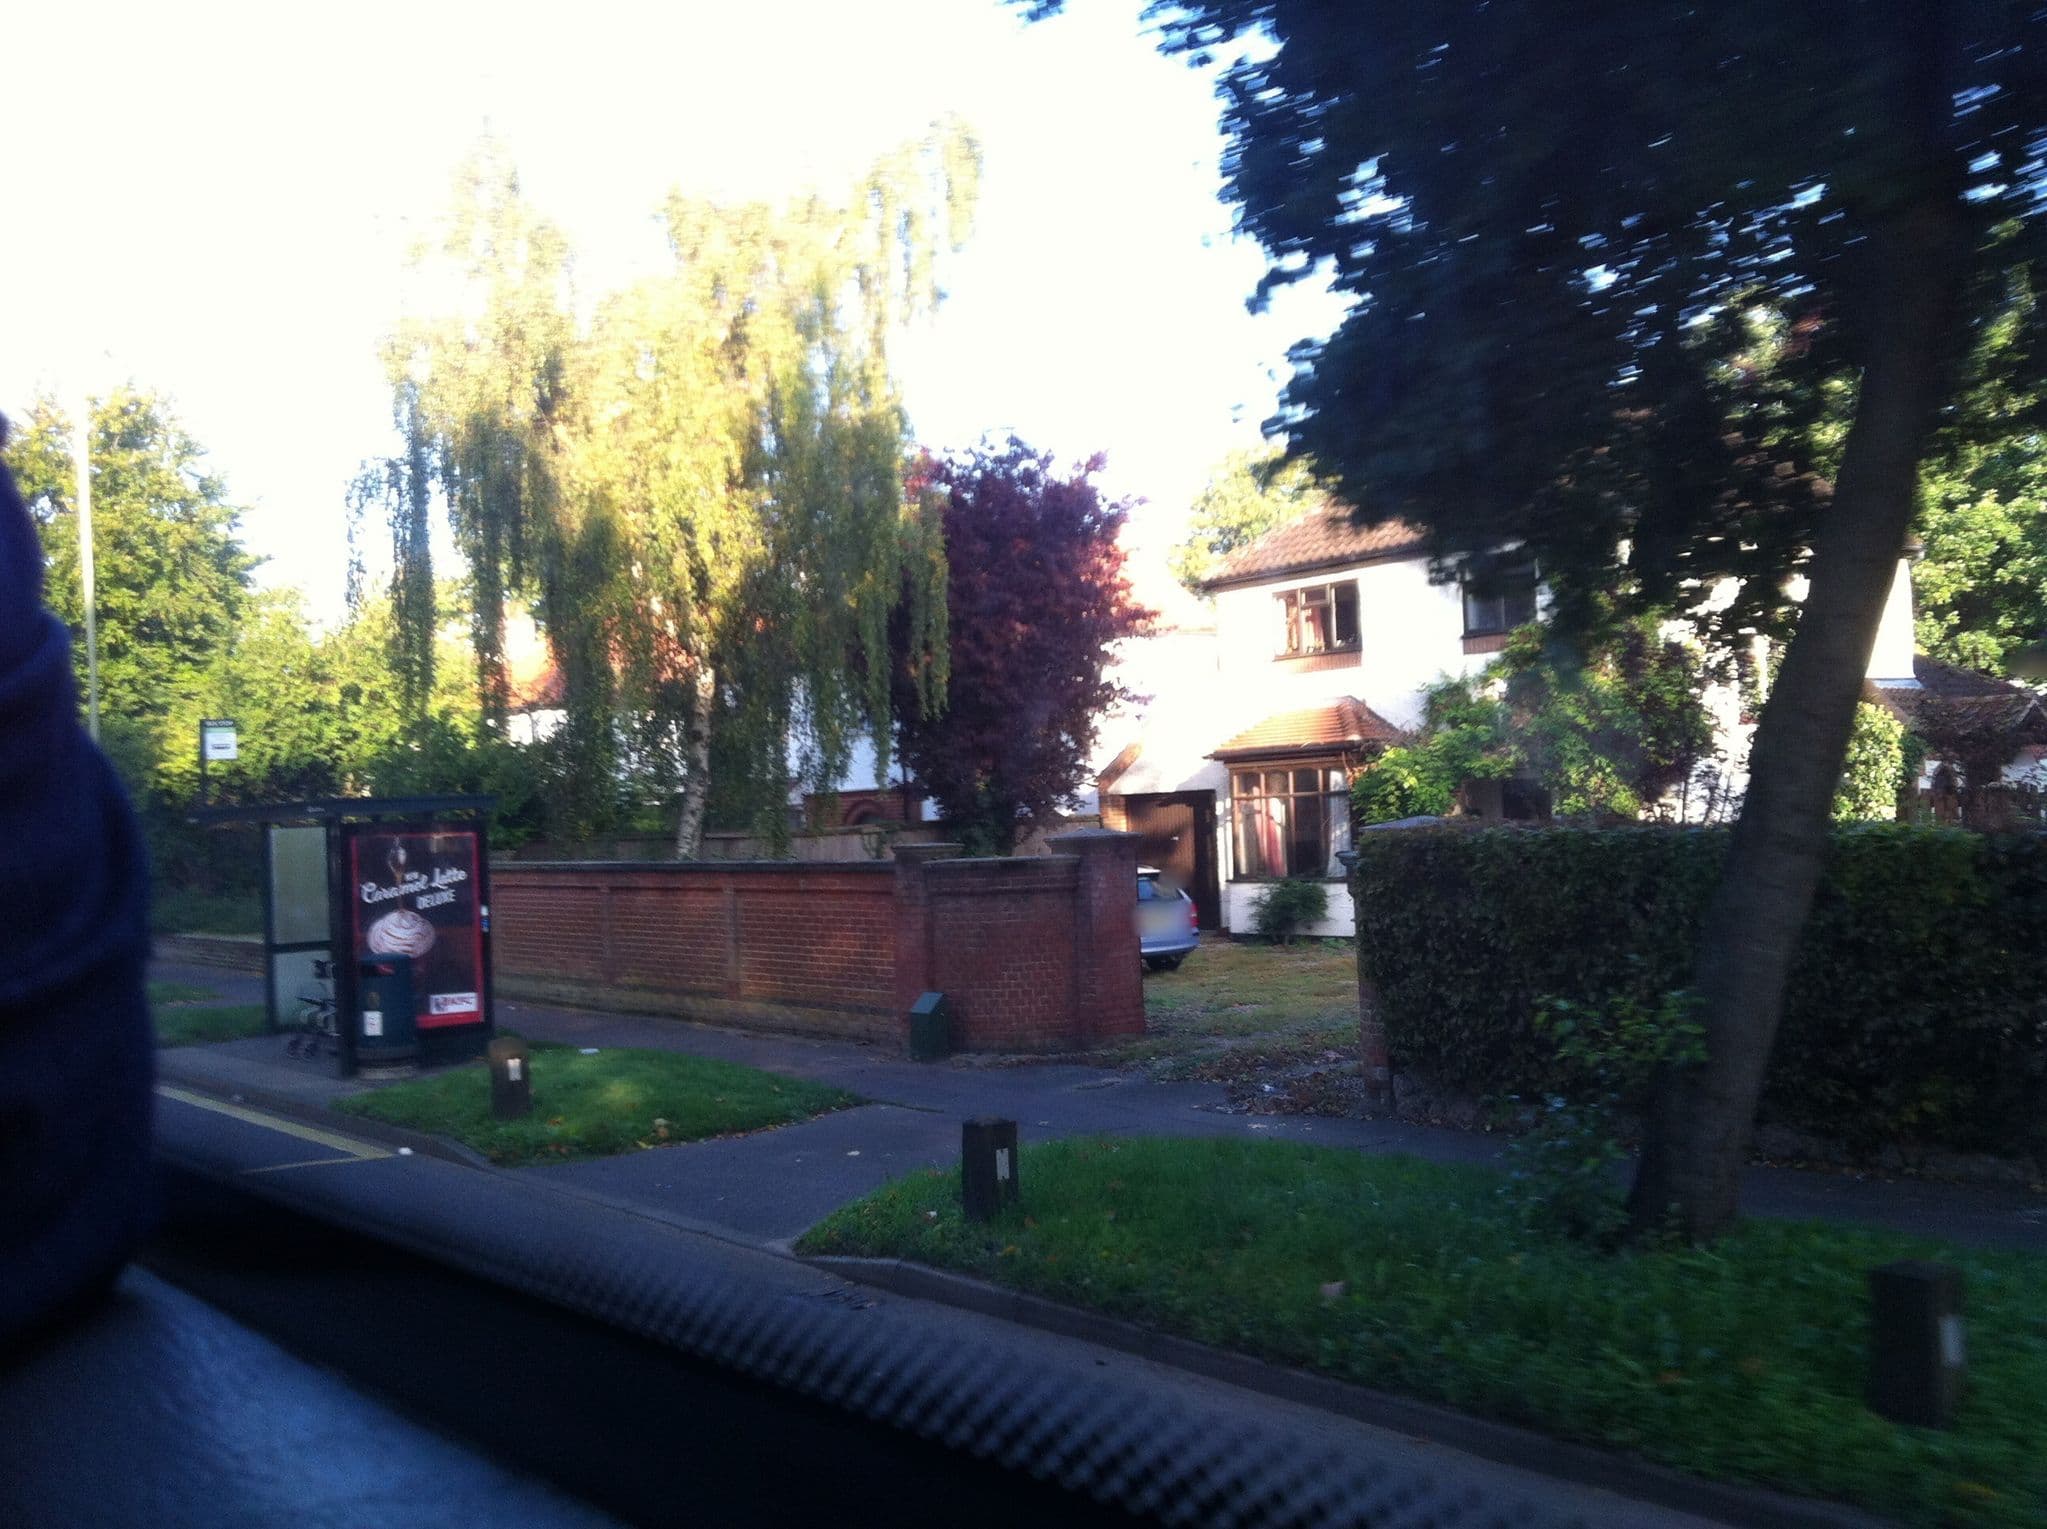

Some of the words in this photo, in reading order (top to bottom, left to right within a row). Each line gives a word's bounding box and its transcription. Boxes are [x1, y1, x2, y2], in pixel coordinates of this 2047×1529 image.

[360, 874, 428, 904] Caramel
[430, 867, 468, 889] Latte
[416, 889, 456, 910] DELUXE
